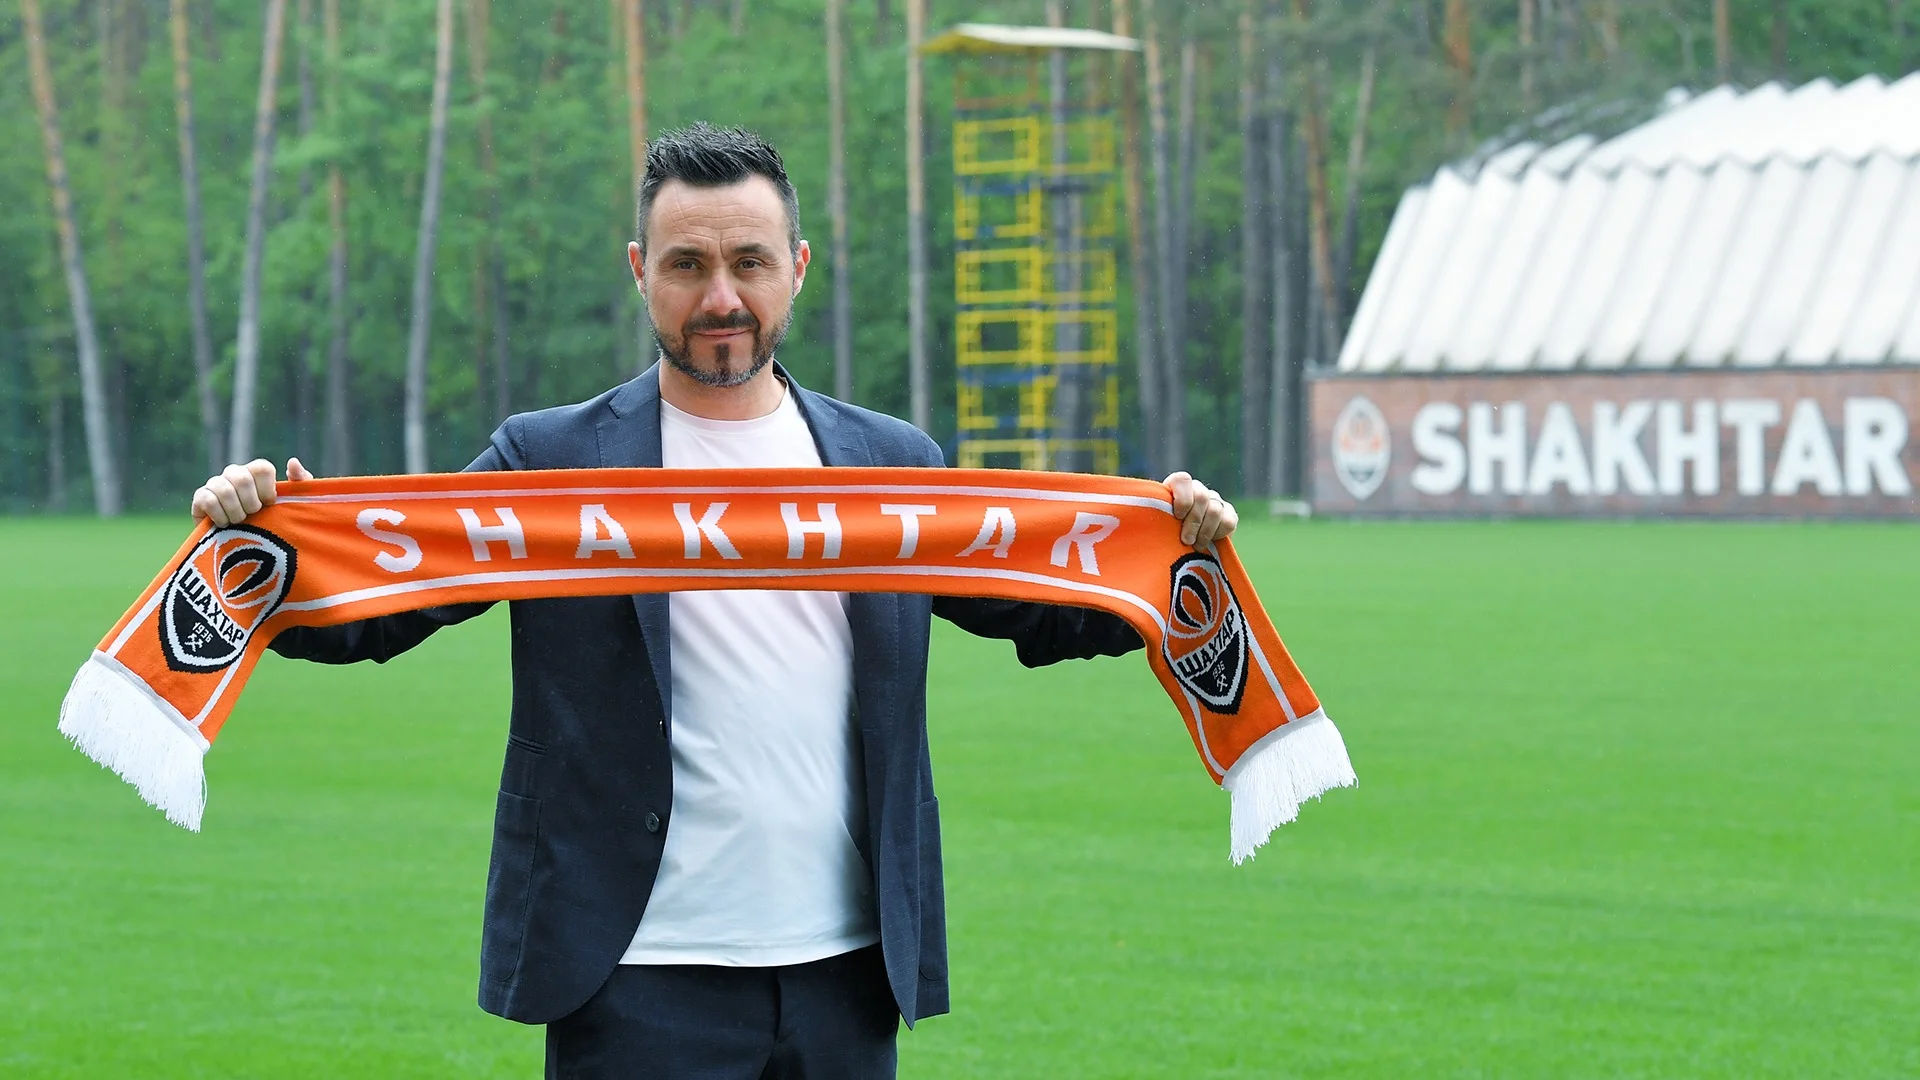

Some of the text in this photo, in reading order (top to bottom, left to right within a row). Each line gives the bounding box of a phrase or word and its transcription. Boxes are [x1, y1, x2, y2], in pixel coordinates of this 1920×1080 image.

[1410, 397, 1912, 497] SHAKHTAR
[355, 502, 1120, 576] SHAKHTAR
[178, 567, 245, 646] ШАХТАР
[191, 621, 214, 644] 1936
[1176, 608, 1235, 679] ШАХТАР
